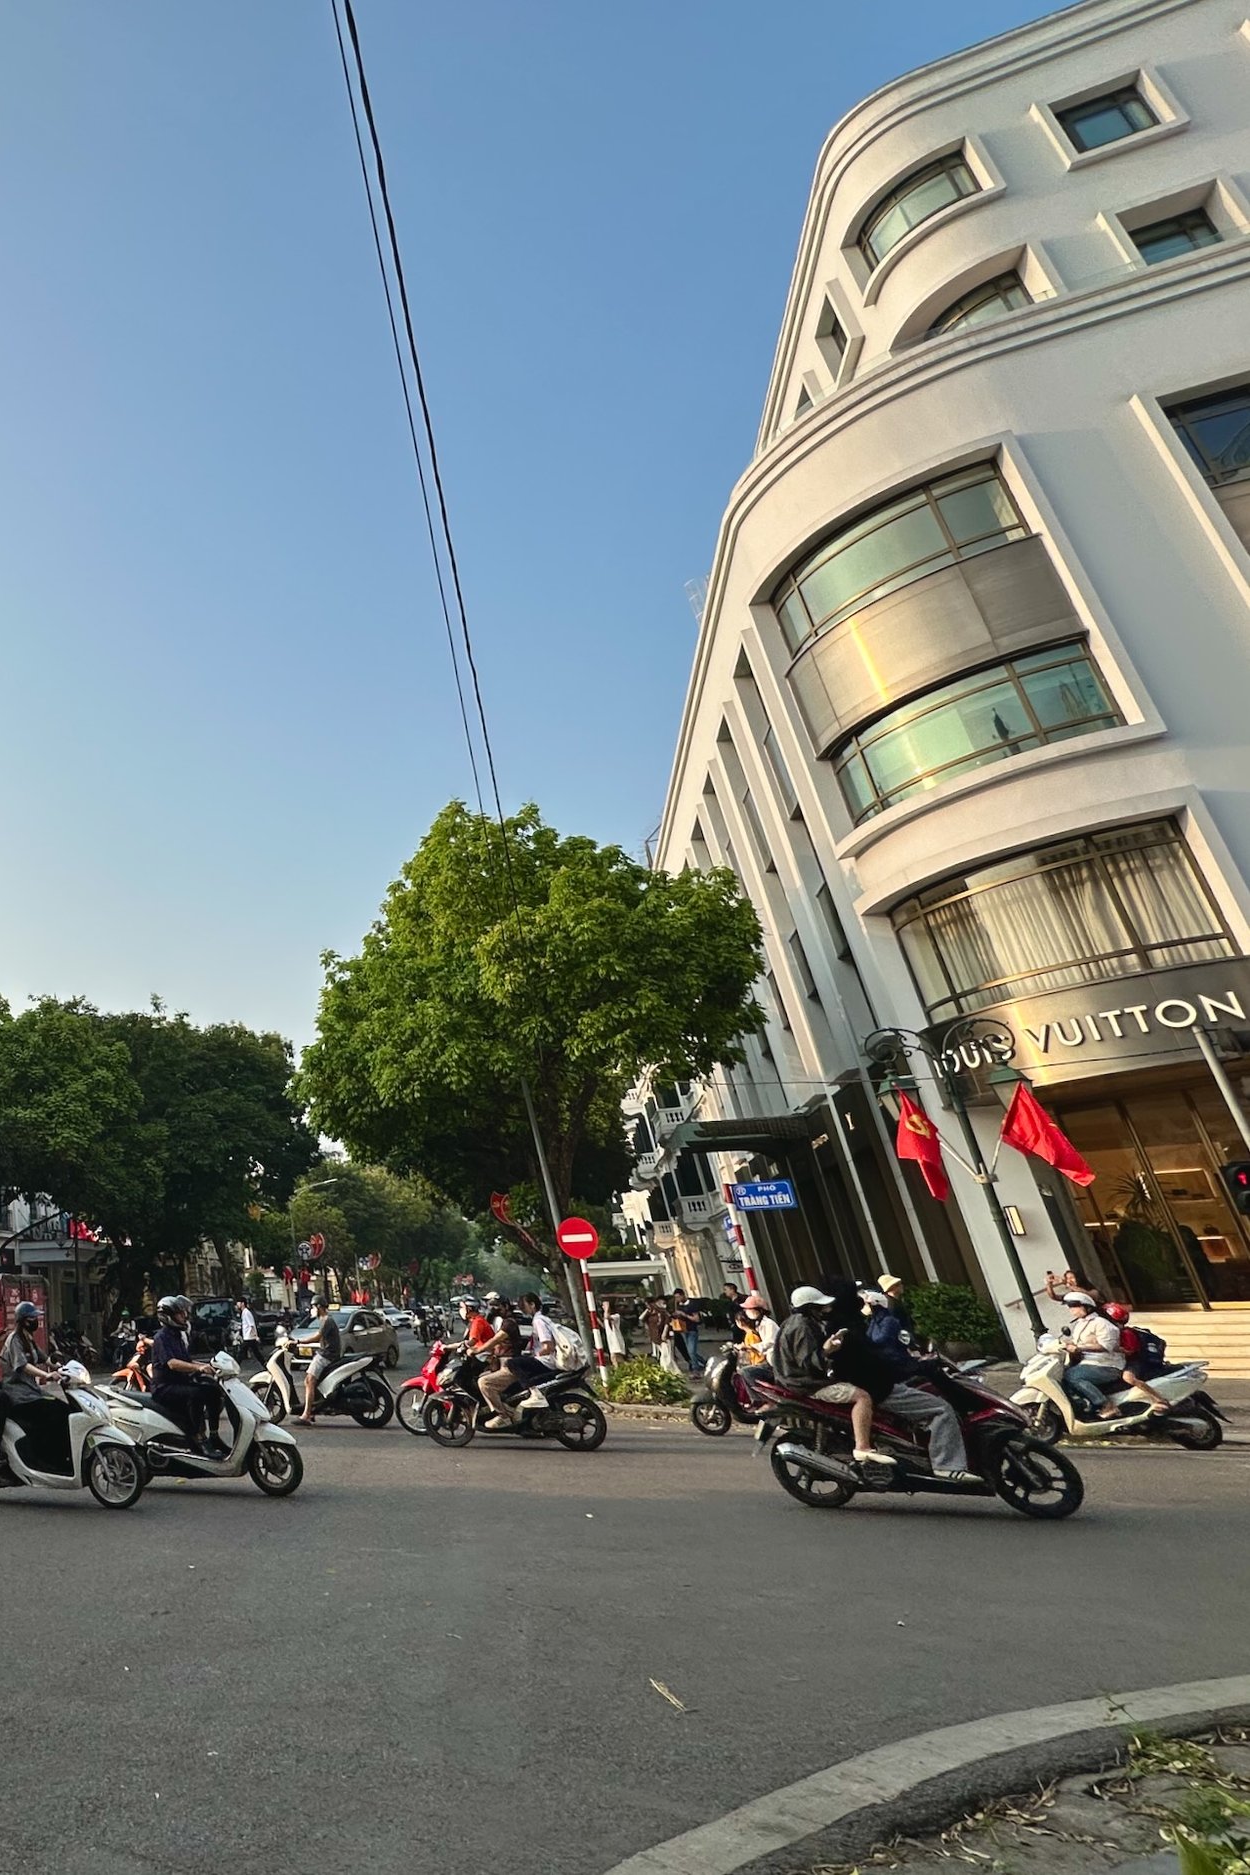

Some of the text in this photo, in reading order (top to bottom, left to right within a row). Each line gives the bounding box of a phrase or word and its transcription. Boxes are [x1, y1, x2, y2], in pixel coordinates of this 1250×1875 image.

[1023, 991, 1246, 1053] VUITTON
[757, 1184, 777, 1192] PHỐ
[738, 1191, 791, 1207] TRÀNG TIỀN
